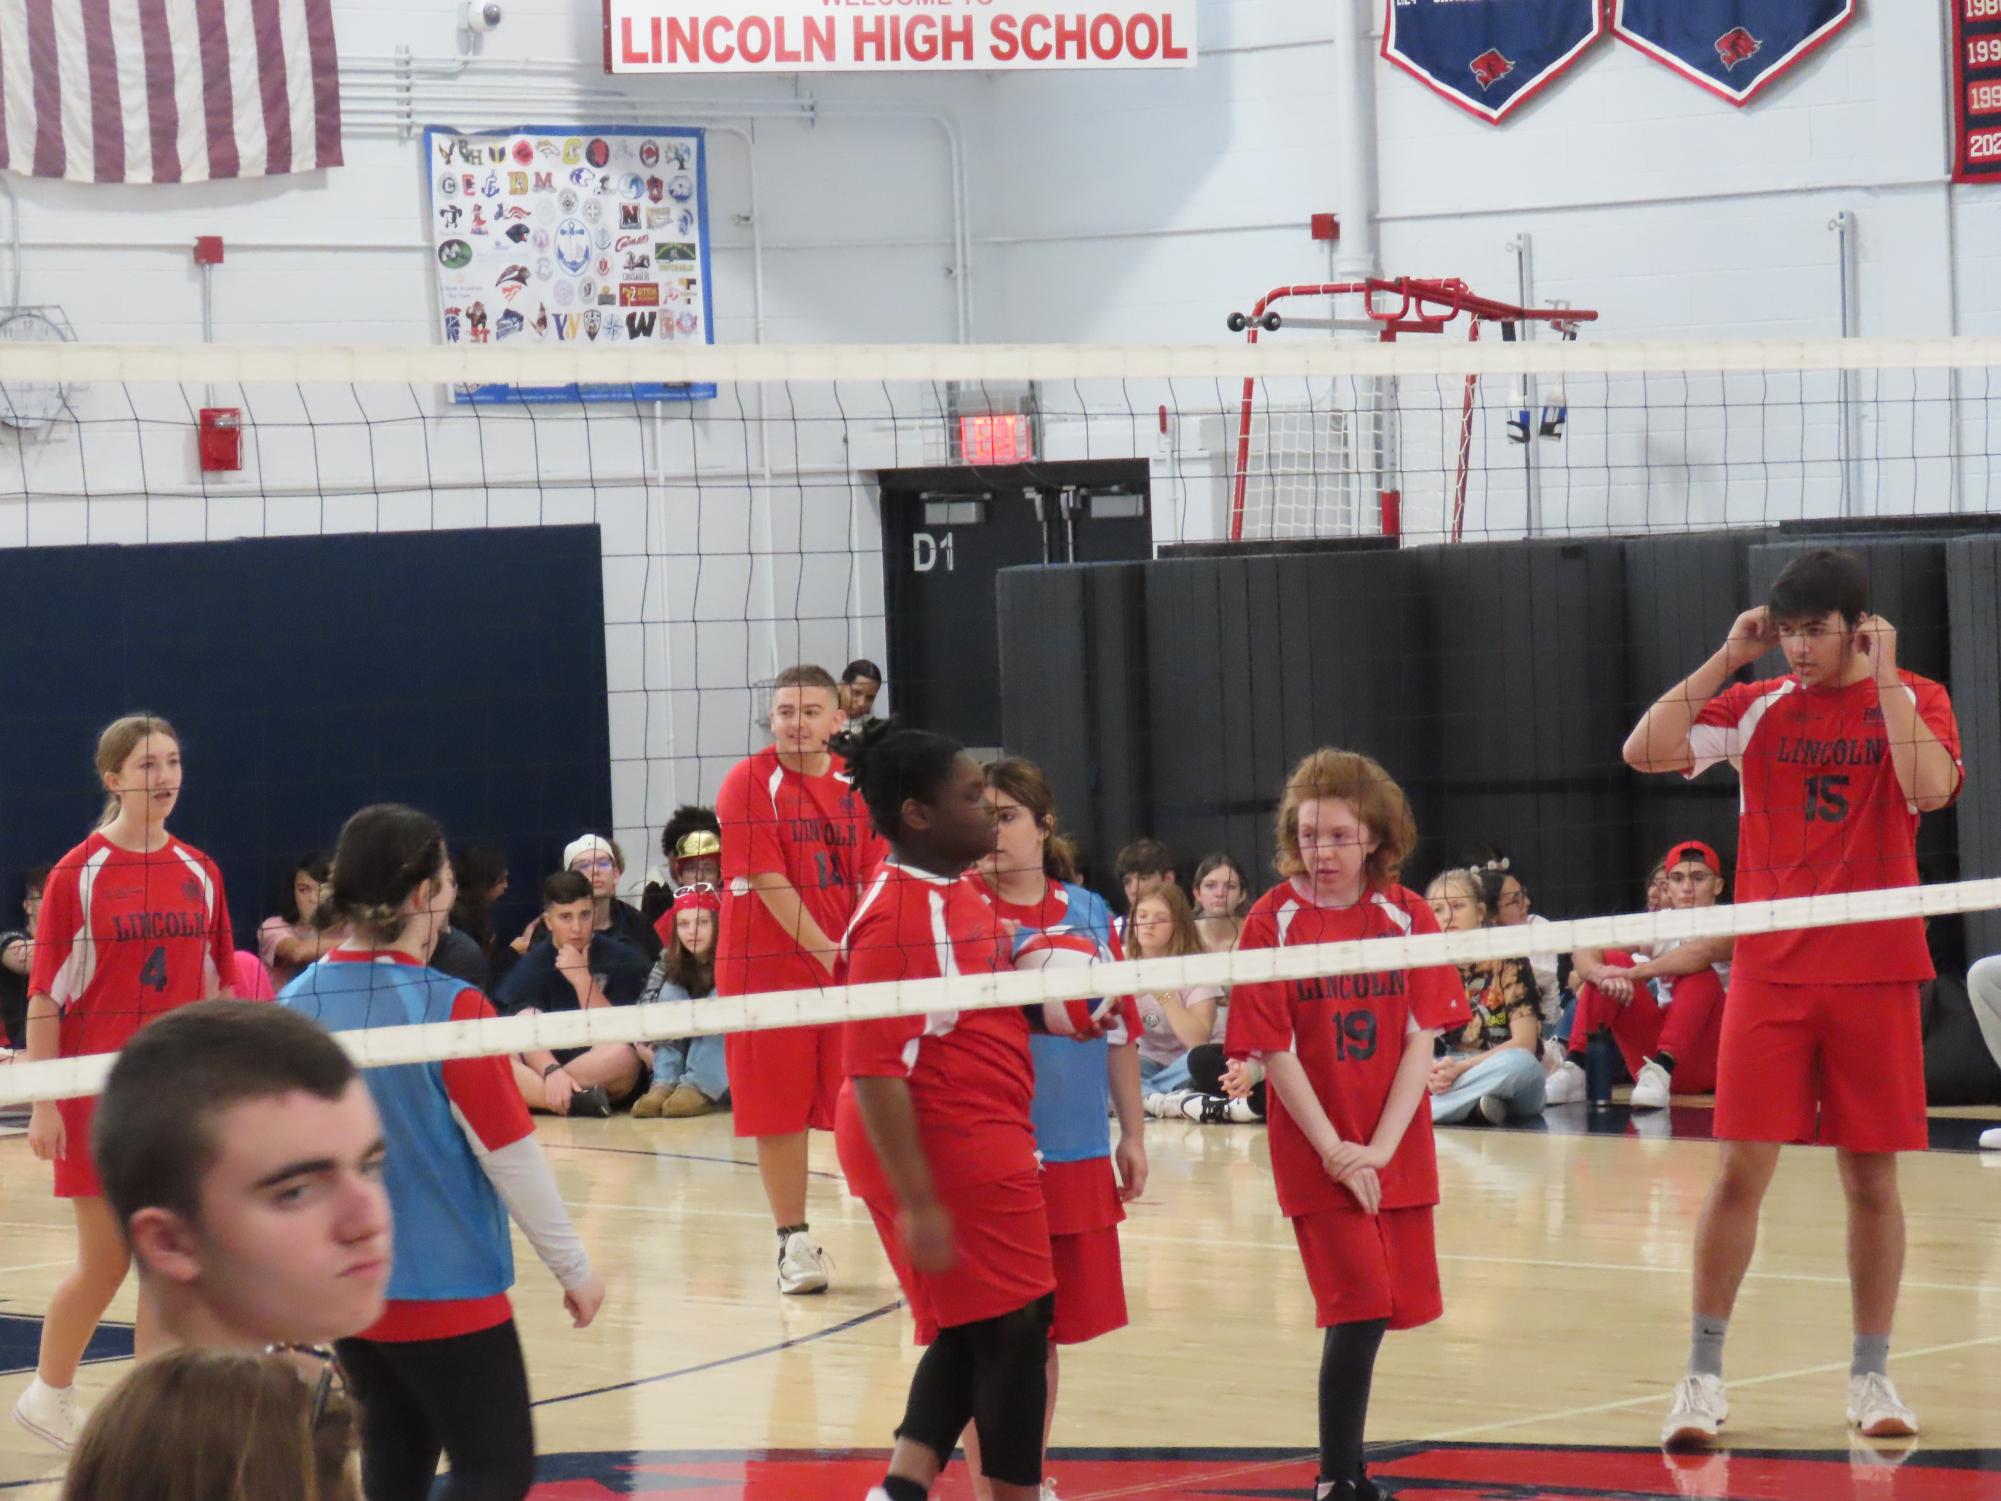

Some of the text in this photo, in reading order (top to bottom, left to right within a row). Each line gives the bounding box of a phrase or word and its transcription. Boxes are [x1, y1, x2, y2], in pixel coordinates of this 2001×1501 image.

[1966, 0, 2001, 17] 198
[621, 12, 1188, 64] LINCOLN HIGH SCHOOL
[913, 532, 954, 572] D1
[1777, 735, 1885, 766] LINCOLN
[1803, 774, 1850, 823] 15
[140, 945, 168, 992] 4
[1297, 968, 1406, 1003] LINCOLN
[1333, 1009, 1378, 1062] 19
